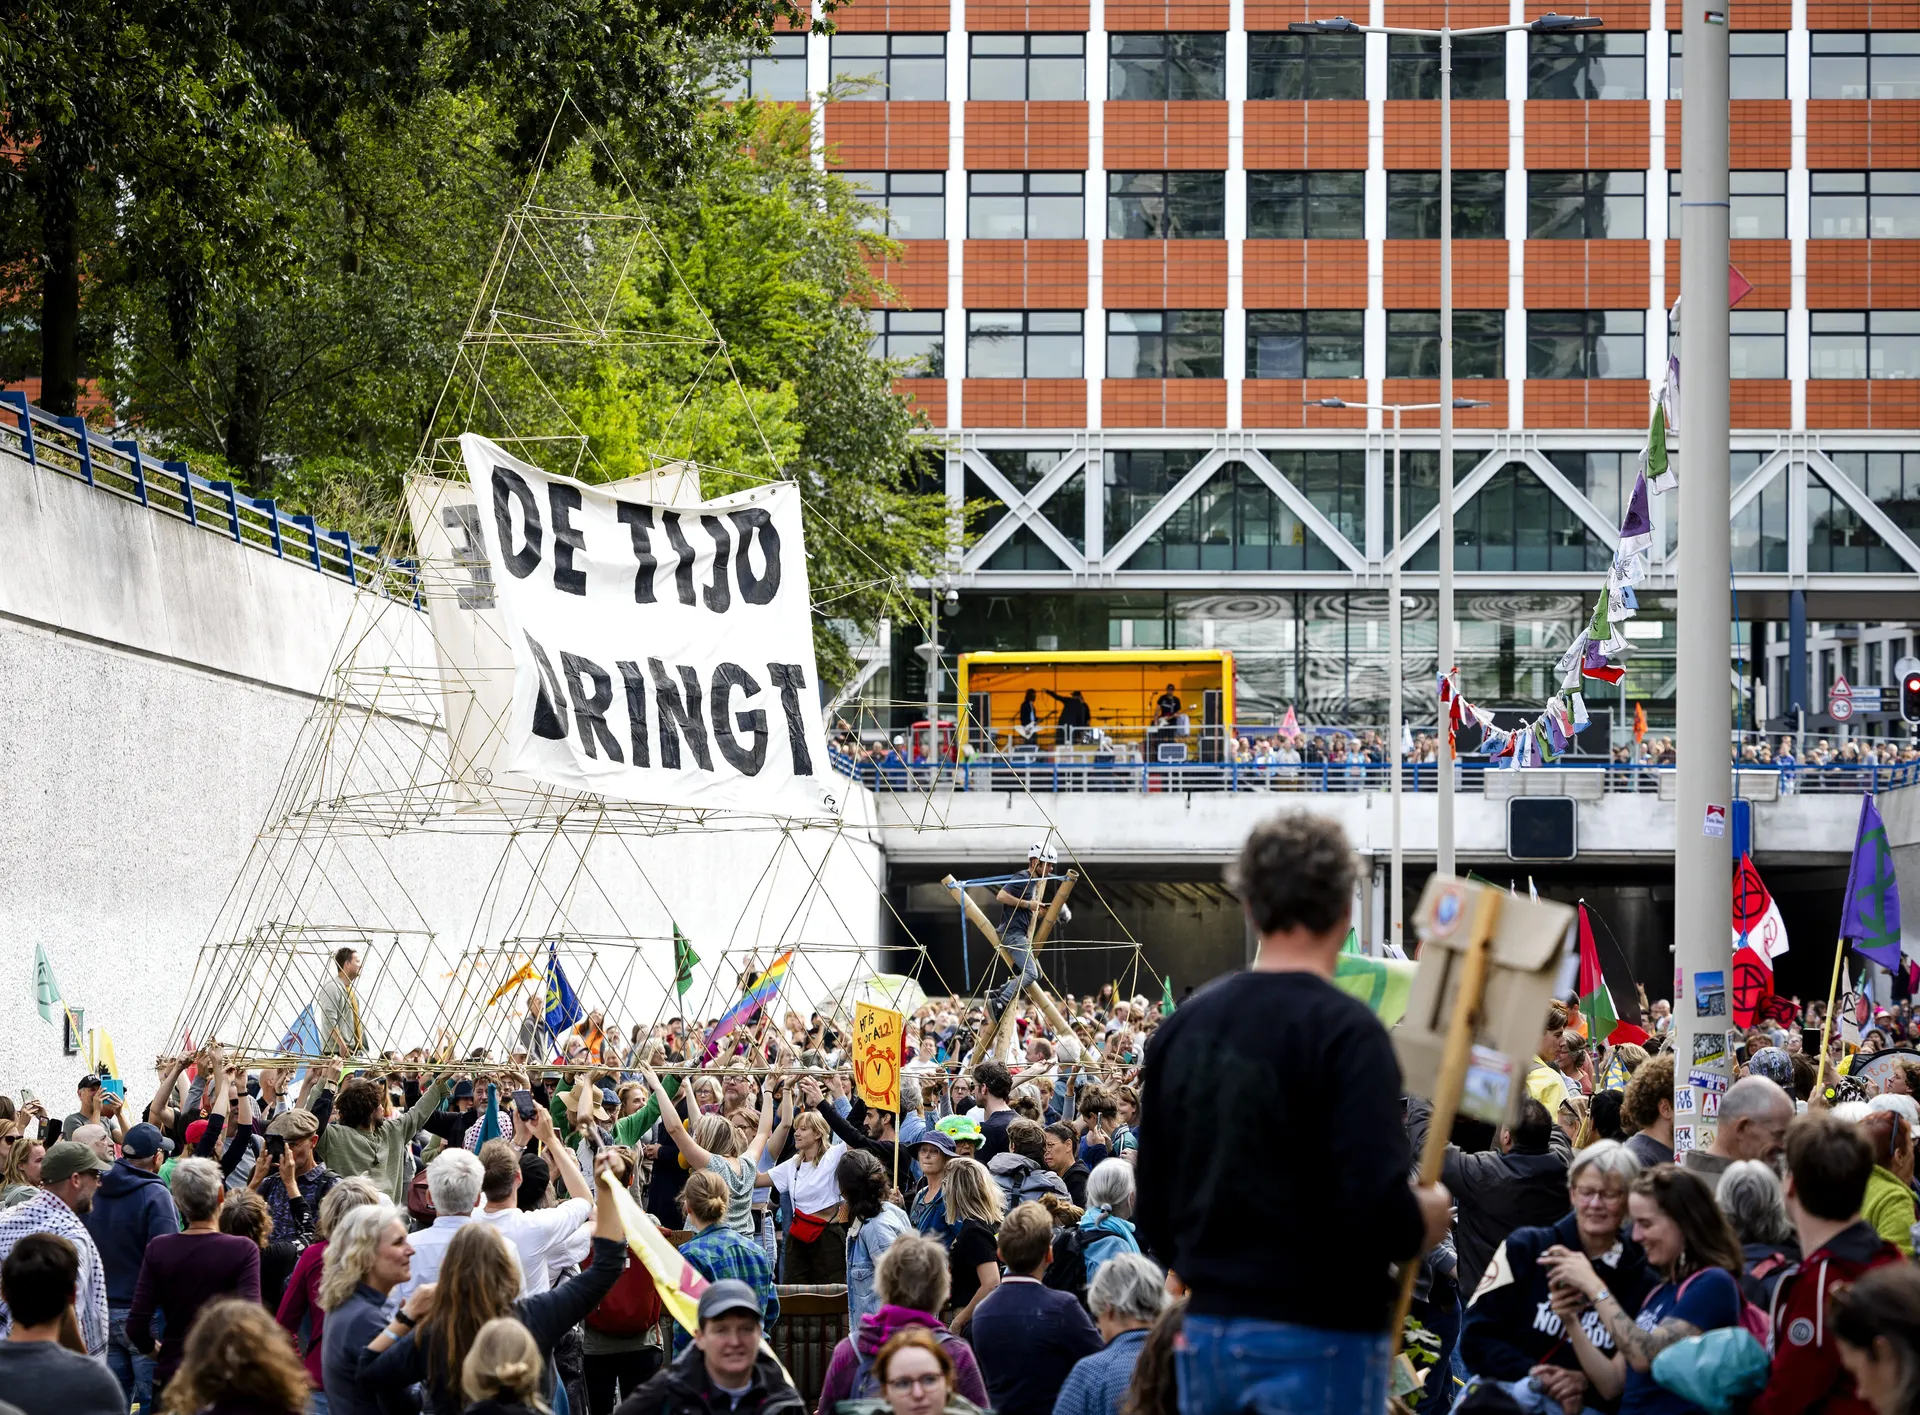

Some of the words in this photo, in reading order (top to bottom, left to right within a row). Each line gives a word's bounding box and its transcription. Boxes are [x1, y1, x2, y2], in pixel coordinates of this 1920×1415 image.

[492, 465, 586, 596] DE
[617, 500, 781, 614] TIJD
[1835, 704, 1849, 713] 30
